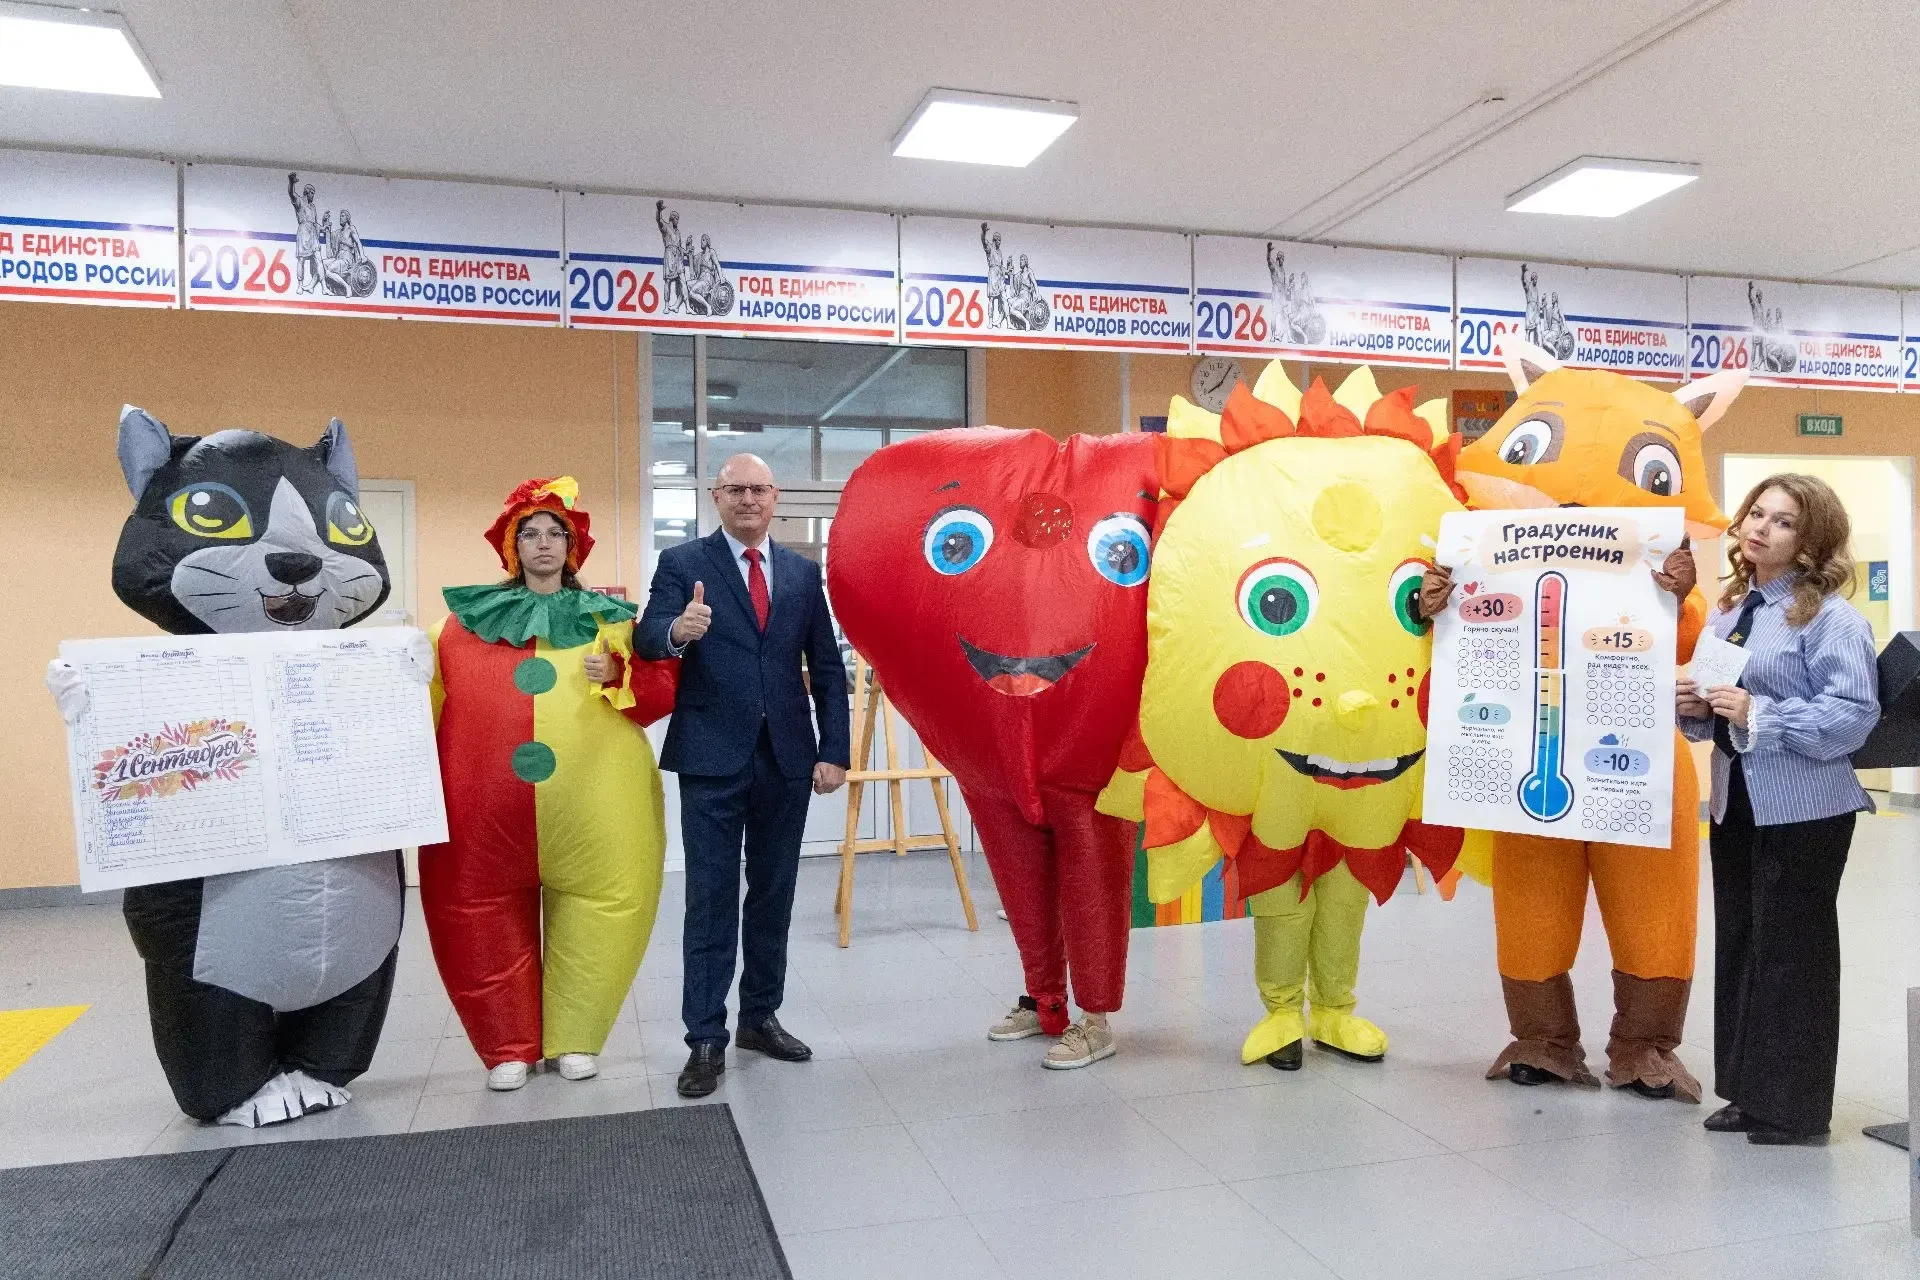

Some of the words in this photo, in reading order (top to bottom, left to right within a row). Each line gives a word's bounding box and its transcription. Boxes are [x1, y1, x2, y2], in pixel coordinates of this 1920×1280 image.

[22, 233, 141, 258] ЕДИНСТВА
[0, 258, 78, 283] РОДОВ
[85, 263, 177, 287] РОССИИ
[188, 244, 291, 293] 2026
[382, 255, 422, 278] ГОД
[428, 258, 531, 281] ЕДИНСТВА
[383, 281, 477, 304] НАРОДОВ
[482, 286, 561, 308] РОССИИ
[569, 267, 659, 314] 2026
[739, 276, 774, 297] ГОД
[739, 300, 822, 322] НАРОДОВ
[827, 304, 896, 324] РОССИИ
[904, 286, 984, 329] 2026
[1053, 294, 1085, 313] ГОД
[1089, 295, 1168, 314] ЕДИНСТВА
[1054, 315, 1126, 336] НАРОДОВ
[1130, 319, 1191, 337] РОССИИ
[1197, 301, 1267, 342] 2026
[1330, 331, 1394, 350] НАРОДОВ
[1397, 335, 1451, 353] РОССИИ
[1577, 328, 1602, 345] ГОД
[1605, 329, 1667, 347] ЕДИНСТВА
[1577, 347, 1634, 366] НАРОДОВ
[1637, 351, 1685, 368] РОССИИ
[1691, 334, 1748, 370] 2026
[1800, 342, 1821, 358] ГОД
[1825, 343, 1882, 359] ЕДИНСТВА
[1800, 360, 1851, 377] НАРОДОВ
[1854, 363, 1899, 378] РОССИИ
[1806, 419, 1836, 434] ВХОД
[1502, 523, 1619, 545] Градусник
[1493, 544, 1624, 565] настроения
[1472, 598, 1504, 618] +30
[1491, 625, 1519, 635] скучал!
[1602, 631, 1633, 649] +15
[1595, 653, 1640, 663] Комфортно,
[1479, 706, 1489, 721] 0
[114, 758, 130, 783] 1
[130, 732, 243, 778] Сентября
[1602, 753, 1630, 772] -10
